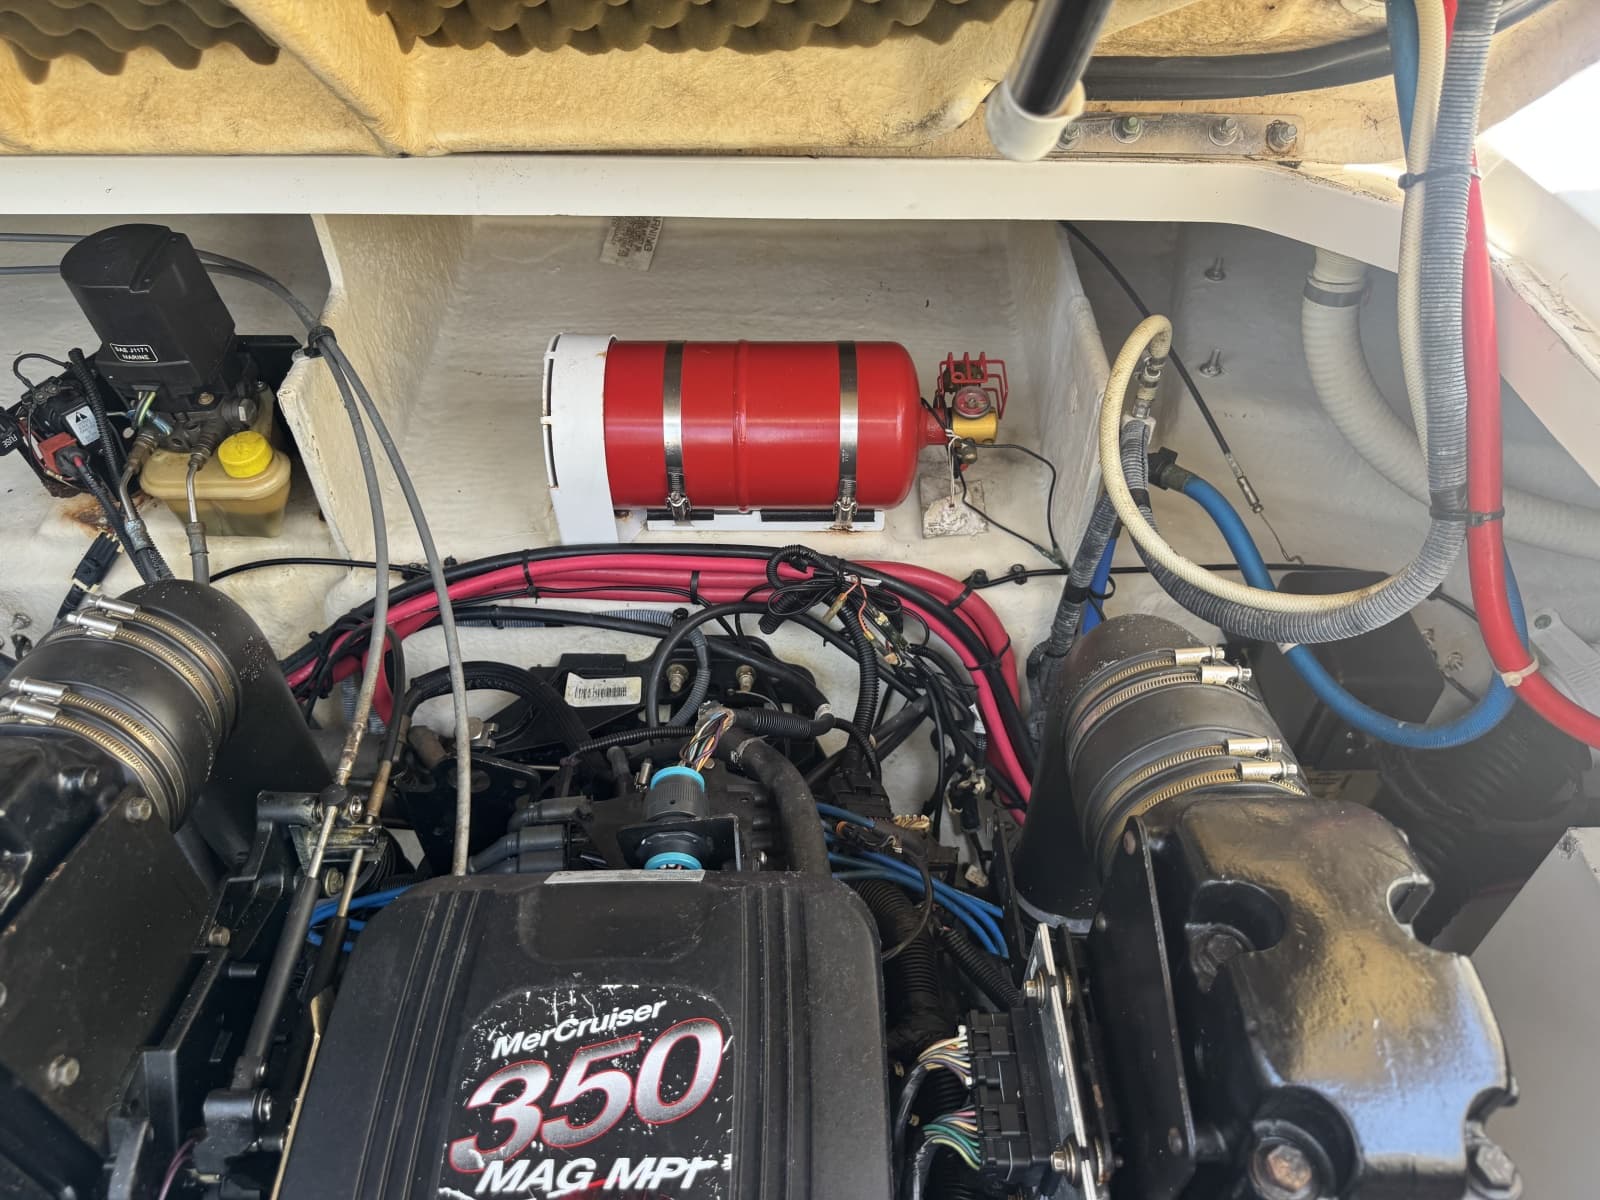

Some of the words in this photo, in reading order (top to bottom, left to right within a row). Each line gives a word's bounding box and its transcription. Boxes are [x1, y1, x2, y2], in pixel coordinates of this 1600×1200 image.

[644, 216, 660, 252] RNING
[2, 433, 18, 448] FUSE
[491, 1000, 667, 1059] MerCruiser
[450, 1017, 724, 1173] 350
[475, 1157, 597, 1195] MAG
[602, 1157, 705, 1190] MPI
